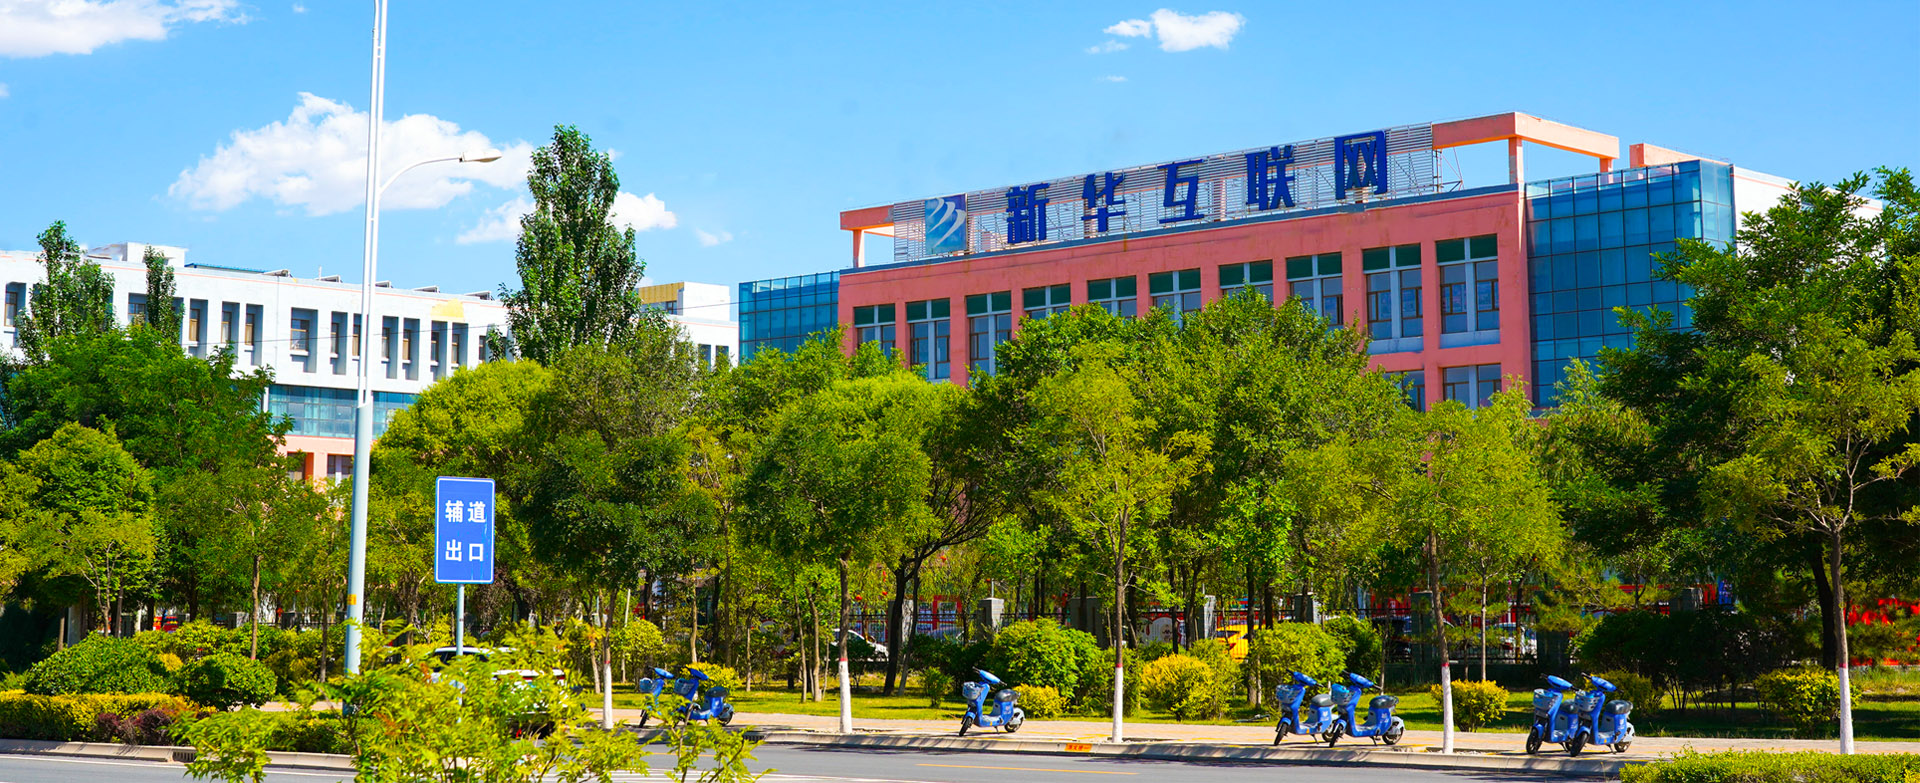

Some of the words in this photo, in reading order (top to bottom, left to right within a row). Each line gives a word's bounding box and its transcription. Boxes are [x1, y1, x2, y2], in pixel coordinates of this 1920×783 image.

[1006, 130, 1387, 243] 新华互联网
[445, 500, 486, 523] 辅道
[445, 539, 484, 561] 出口
